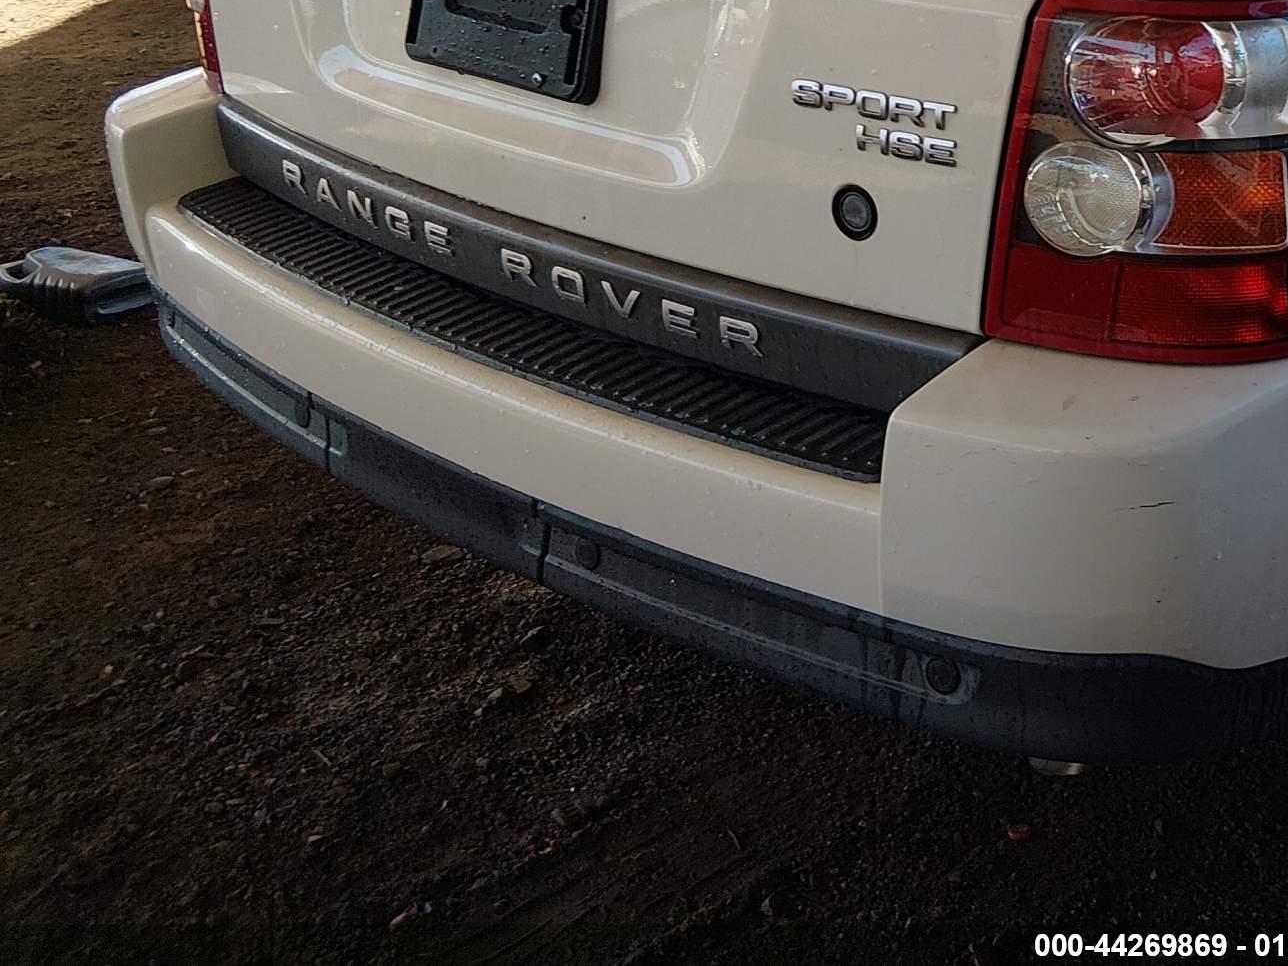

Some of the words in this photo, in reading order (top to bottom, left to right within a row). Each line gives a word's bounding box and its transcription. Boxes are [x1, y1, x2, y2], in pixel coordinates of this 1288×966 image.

[791, 78, 958, 130] SPORT
[856, 123, 958, 168] HSE
[282, 159, 455, 257] RANGE
[500, 247, 766, 359] ROVER
